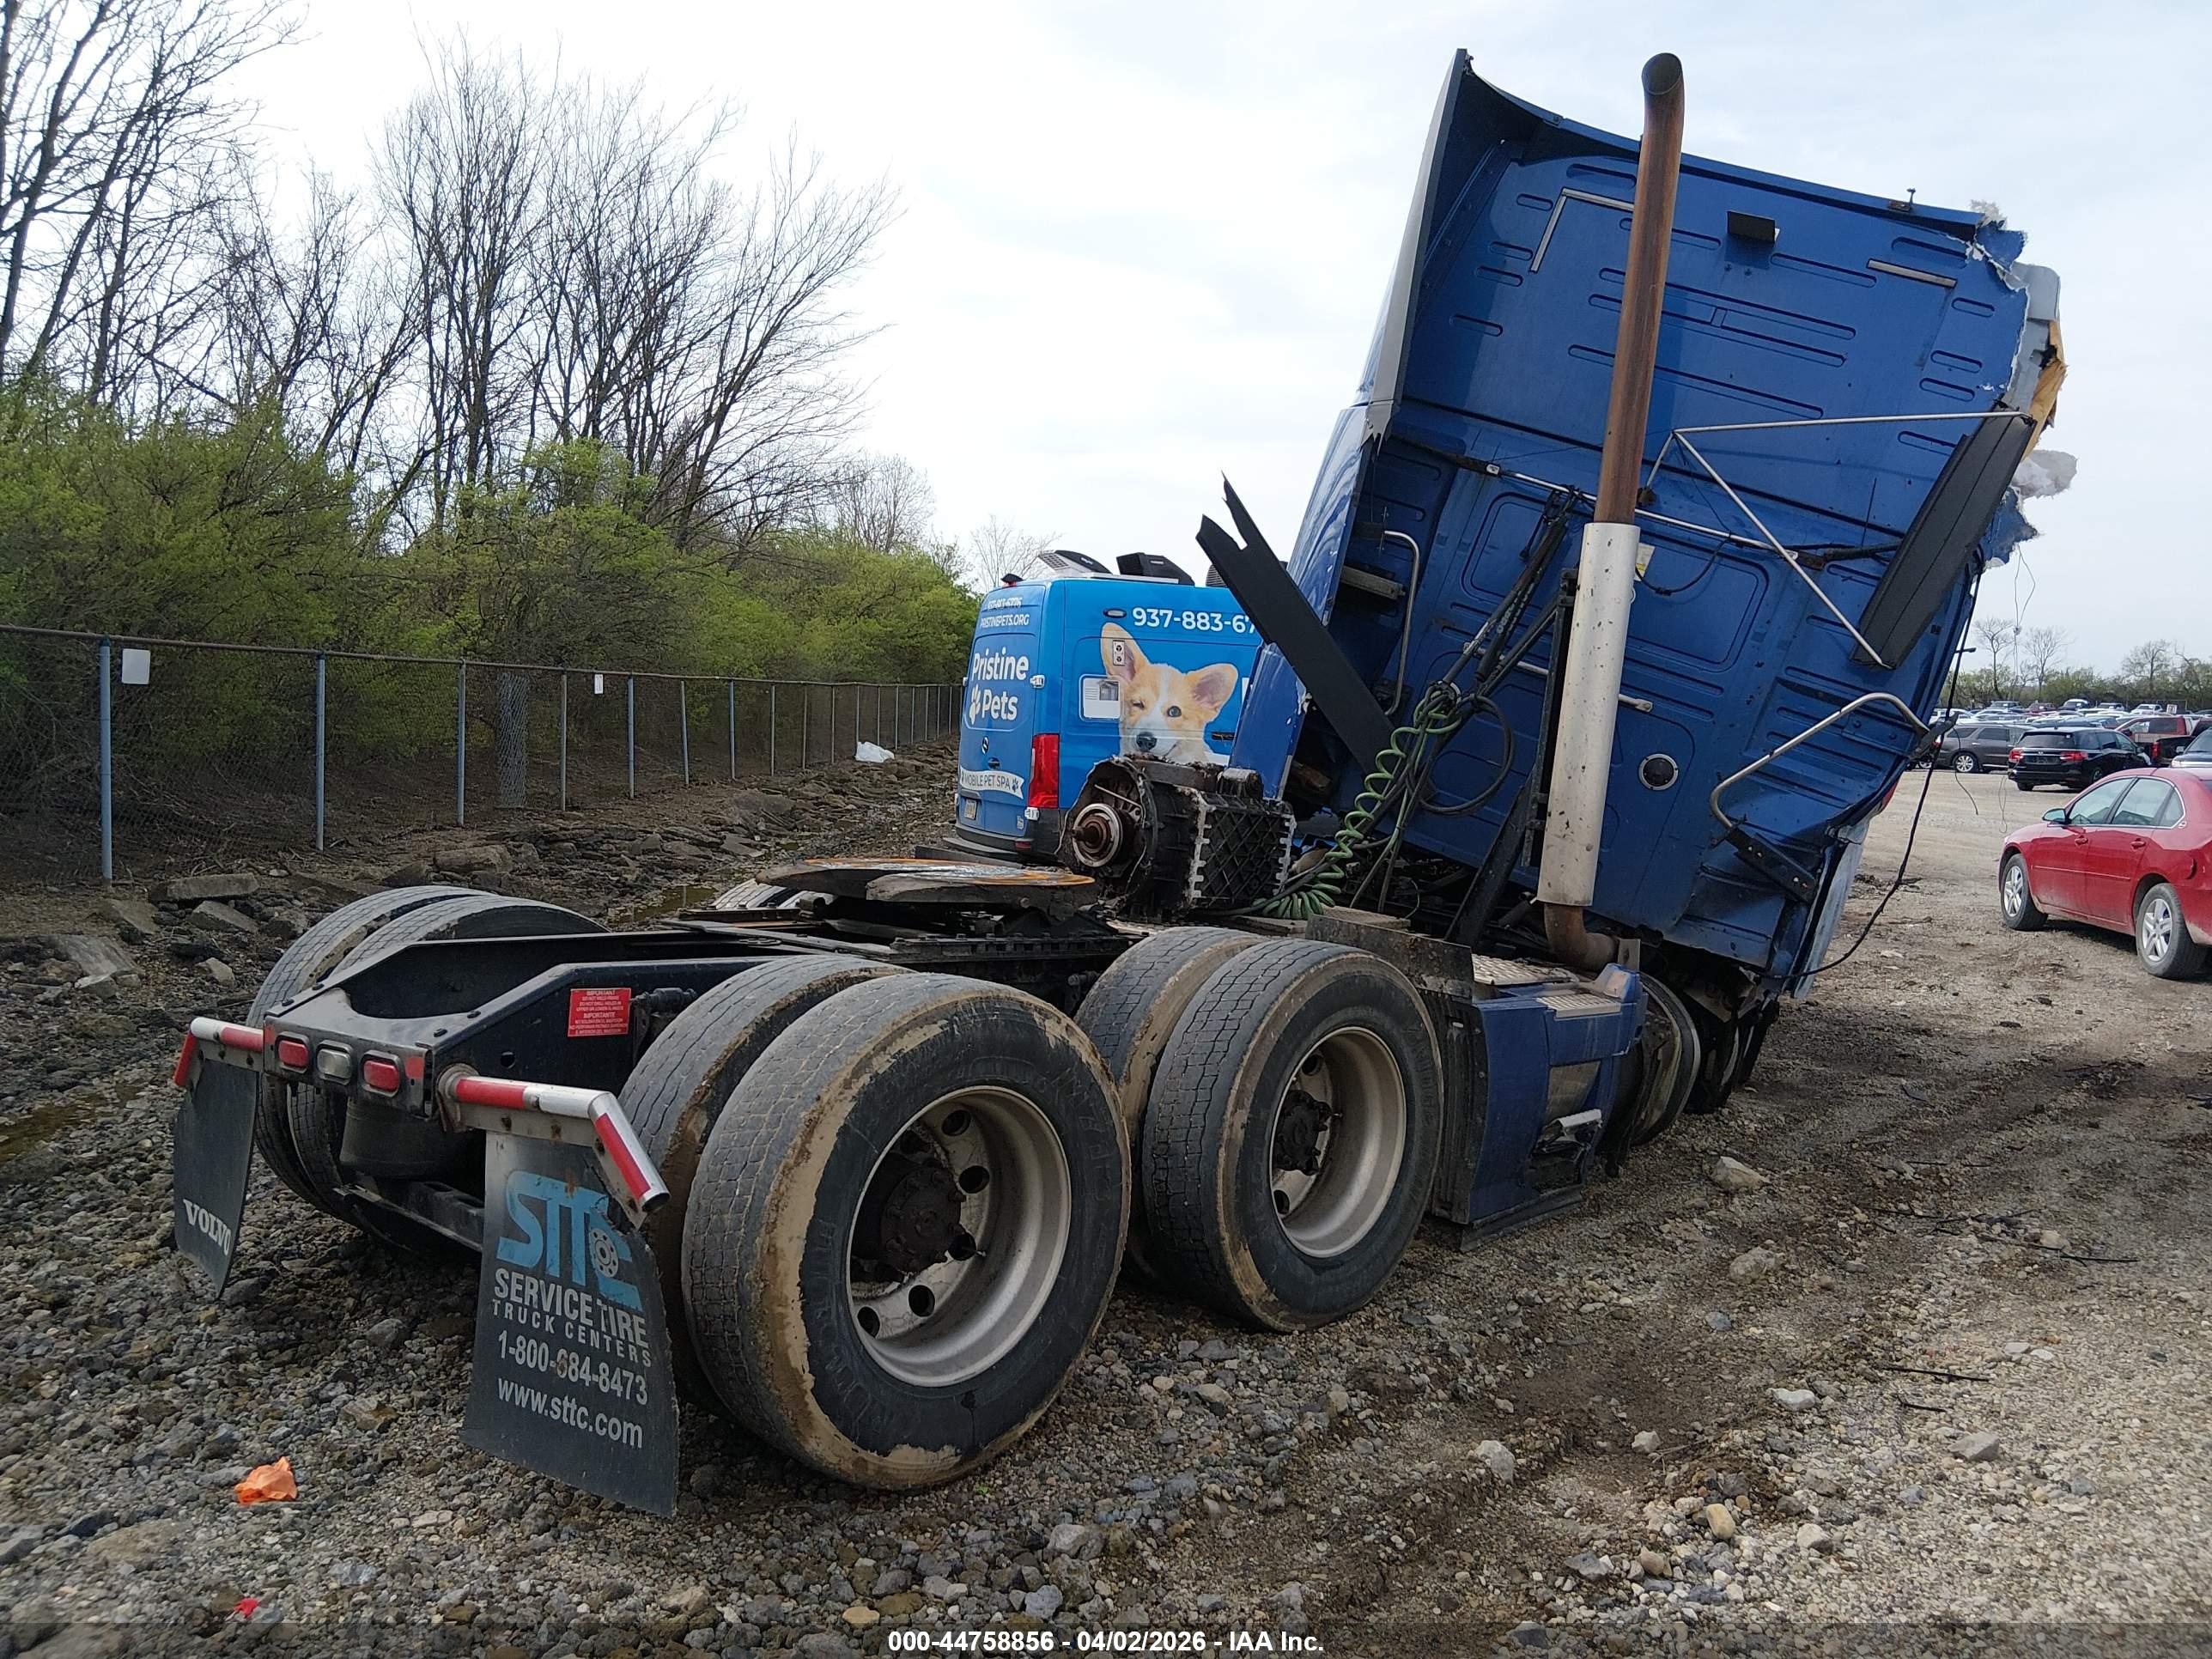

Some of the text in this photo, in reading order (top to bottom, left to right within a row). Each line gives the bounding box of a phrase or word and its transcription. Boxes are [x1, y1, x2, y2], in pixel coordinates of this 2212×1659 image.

[972, 646, 1030, 681] Pristine
[981, 689, 1018, 721] Pets
[964, 773, 1011, 790] MOBILE PET SPA
[183, 1198, 232, 1256] VOLVO
[492, 1298, 652, 1368] TRUCK CENTERS
[494, 1267, 649, 1349] SERVICE TIRE
[498, 1329, 648, 1406] 1-800-684-8473
[498, 1377, 643, 1449] www.sttc.com
